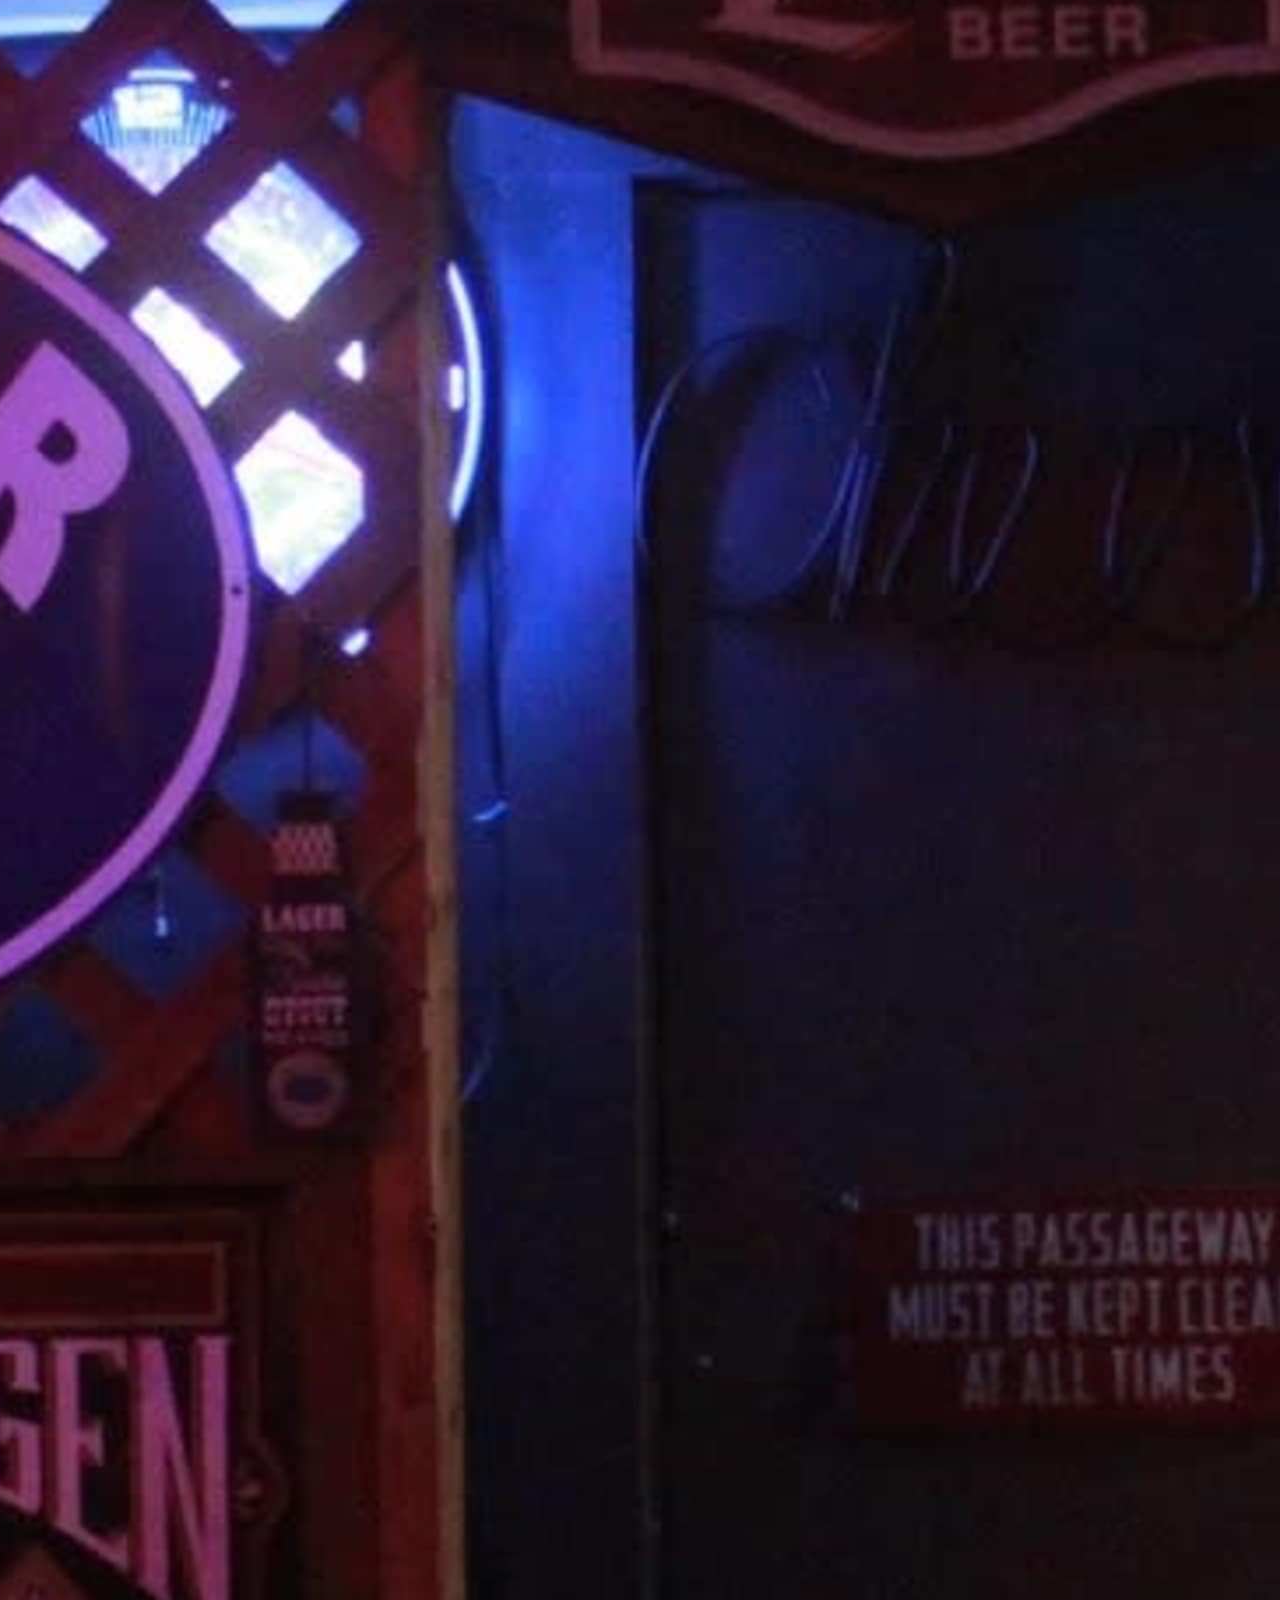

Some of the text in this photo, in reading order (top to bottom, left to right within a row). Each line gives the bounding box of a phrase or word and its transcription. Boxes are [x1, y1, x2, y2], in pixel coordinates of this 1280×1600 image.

[948, 2, 1149, 62] BEER
[913, 1207, 1277, 1270] THIS PASSAGEWAY
[887, 1282, 994, 1342] MUST
[1007, 1281, 1056, 1338] BE
[1066, 1277, 1166, 1338] KEPT
[960, 1346, 1237, 1410] AT ALL TIMES
